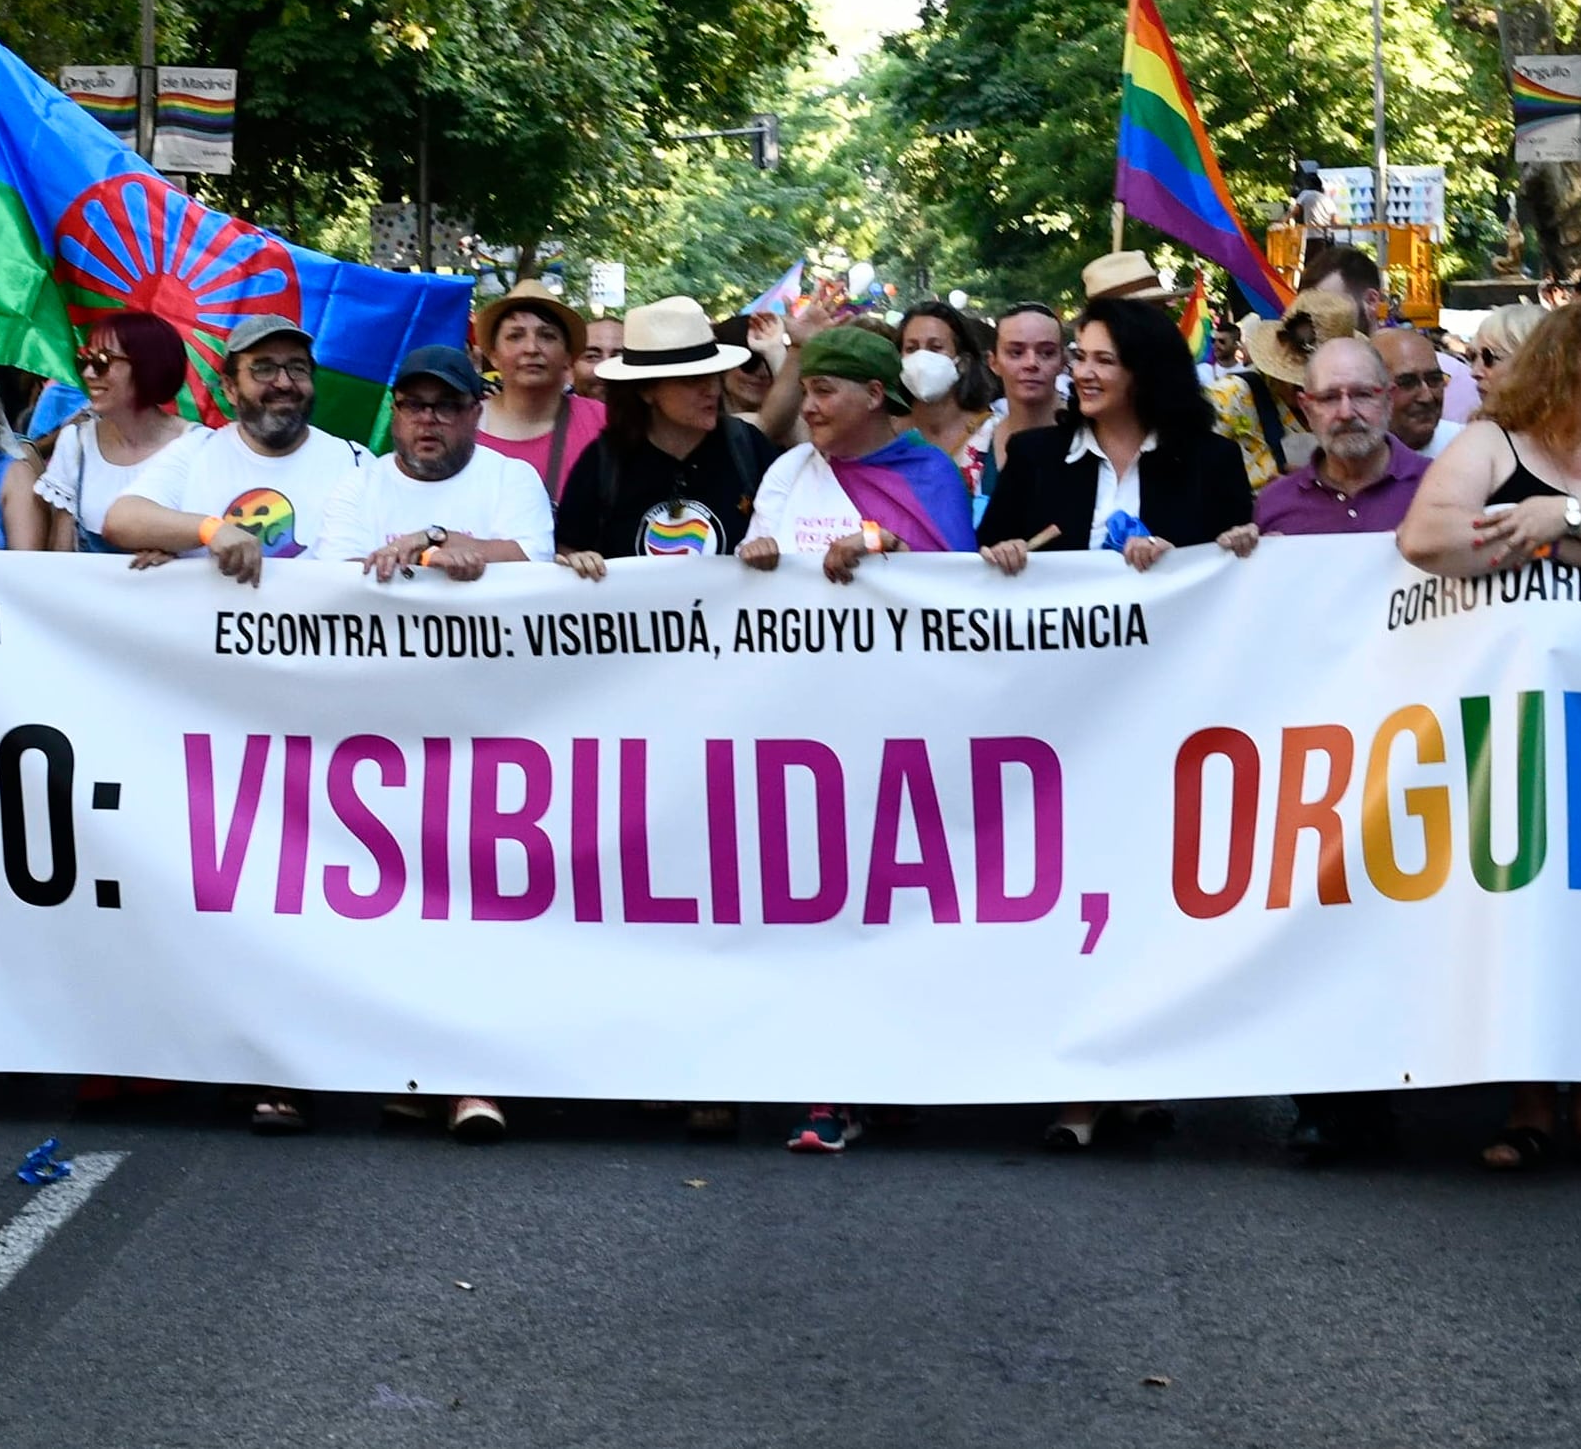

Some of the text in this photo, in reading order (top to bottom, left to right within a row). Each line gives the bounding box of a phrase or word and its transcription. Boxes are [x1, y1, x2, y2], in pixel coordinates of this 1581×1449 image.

[162, 77, 179, 89] de
[216, 600, 1149, 661] ESCONTRA L'ODIU: VISIBILIDÁ, ARGUYU Y RESILIENCIA
[182, 732, 1111, 955] VISIBILIDAD,
